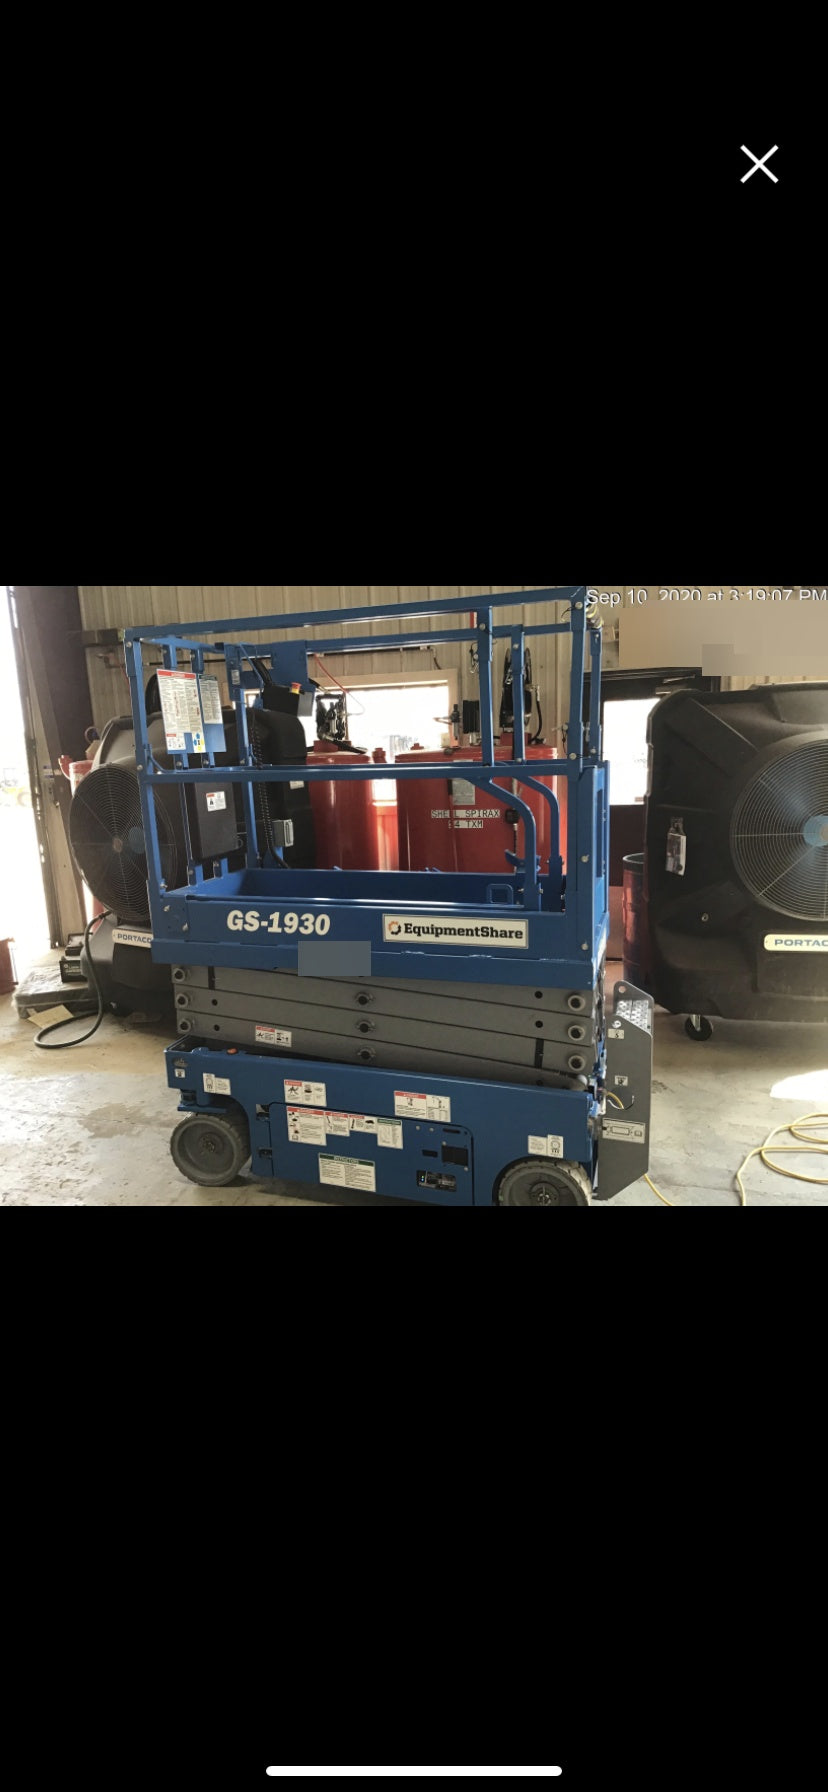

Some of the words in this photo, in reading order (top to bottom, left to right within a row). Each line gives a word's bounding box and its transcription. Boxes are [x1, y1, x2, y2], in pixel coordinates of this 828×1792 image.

[431, 809, 460, 818] SHEL
[465, 809, 499, 818] SPIRAX
[466, 820, 483, 828] TXM
[226, 909, 331, 936] GS-1930
[403, 922, 524, 940] EquipmentShare
